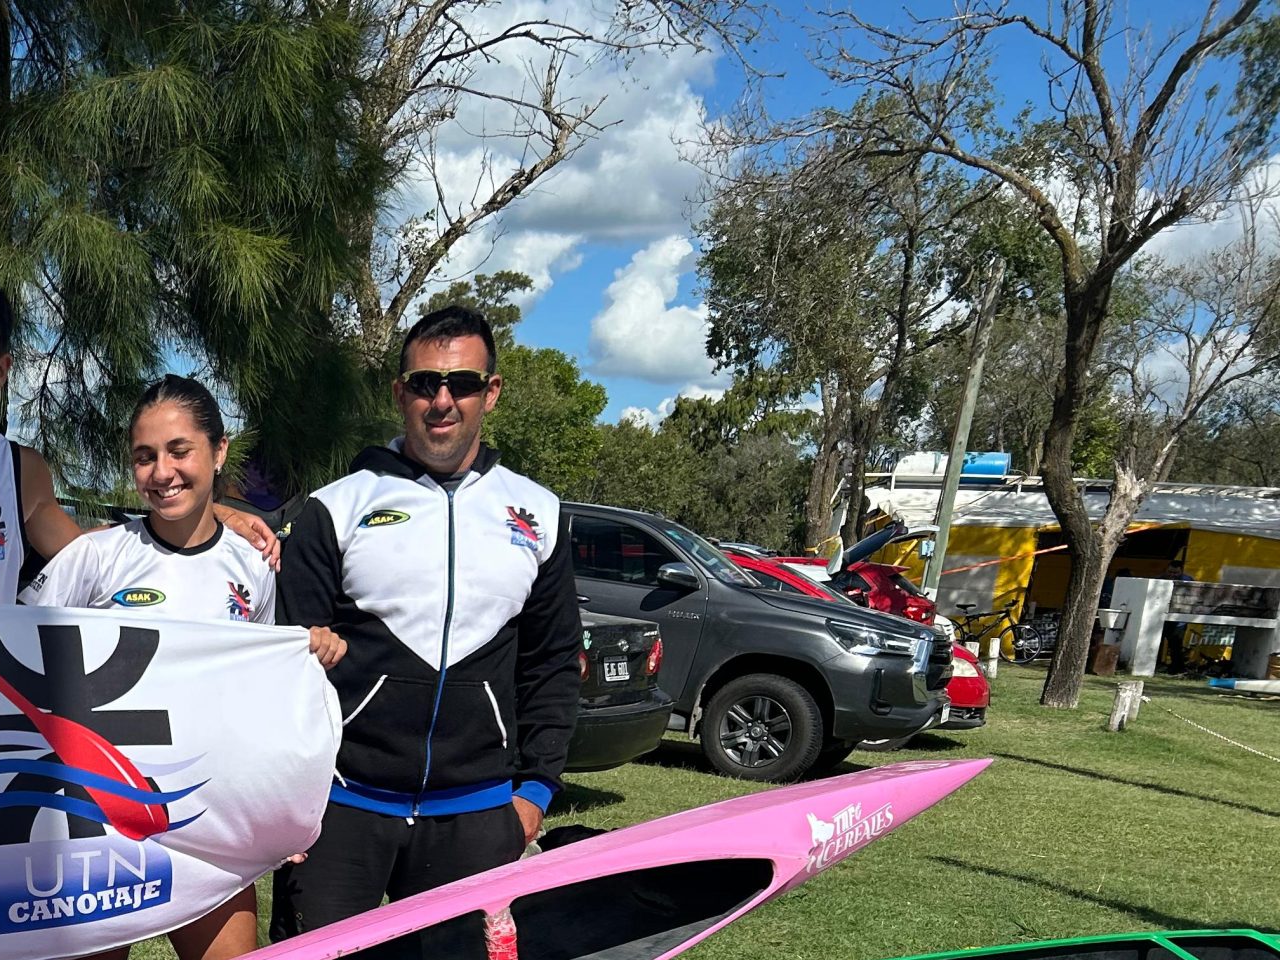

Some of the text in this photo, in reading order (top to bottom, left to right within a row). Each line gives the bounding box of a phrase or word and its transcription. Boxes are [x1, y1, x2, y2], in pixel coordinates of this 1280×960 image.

[367, 515, 395, 526] ASAK
[125, 593, 151, 602] ASAK
[25, 842, 147, 898] UTN
[8, 879, 162, 924] CANOTAJE
